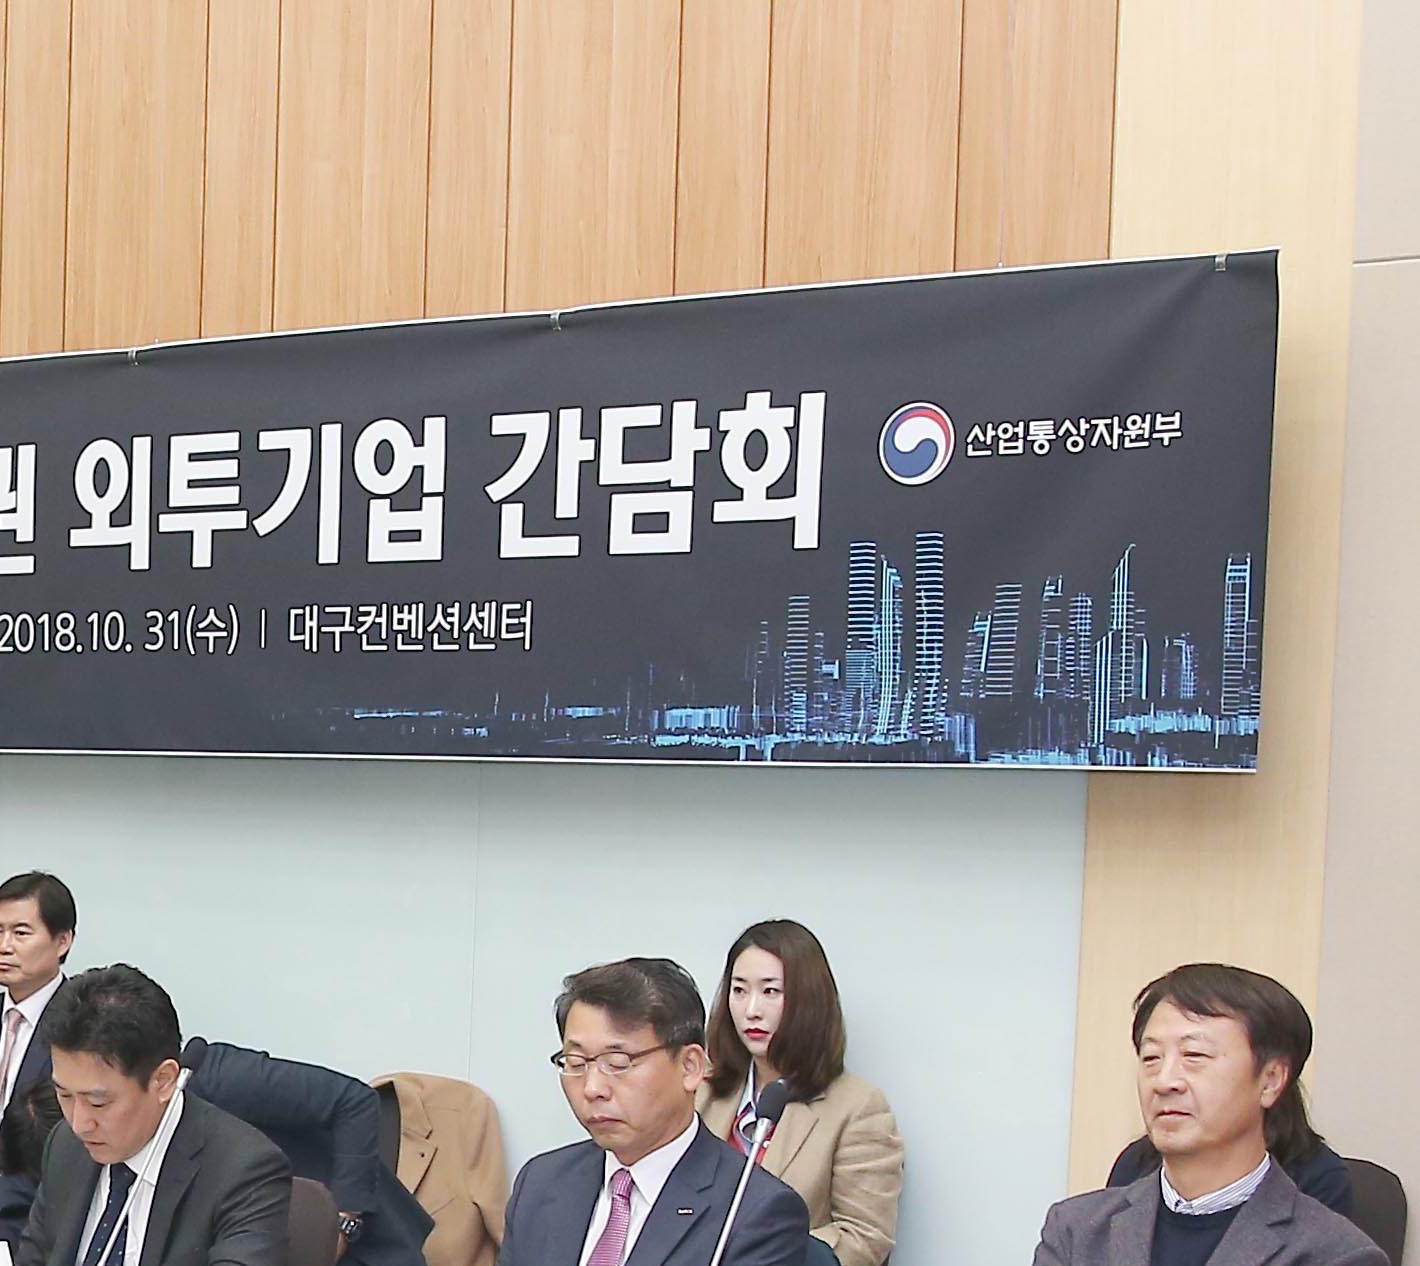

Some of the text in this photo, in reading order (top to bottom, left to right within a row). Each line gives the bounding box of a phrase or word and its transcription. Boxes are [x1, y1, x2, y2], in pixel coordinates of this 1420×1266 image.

[966, 411, 1182, 458] 산업통상자원부
[69, 416, 446, 570] 외투기업
[484, 391, 826, 558] 간담회
[144, 603, 240, 656] 31(수)
[288, 599, 533, 653] 대구컨벤션센터
